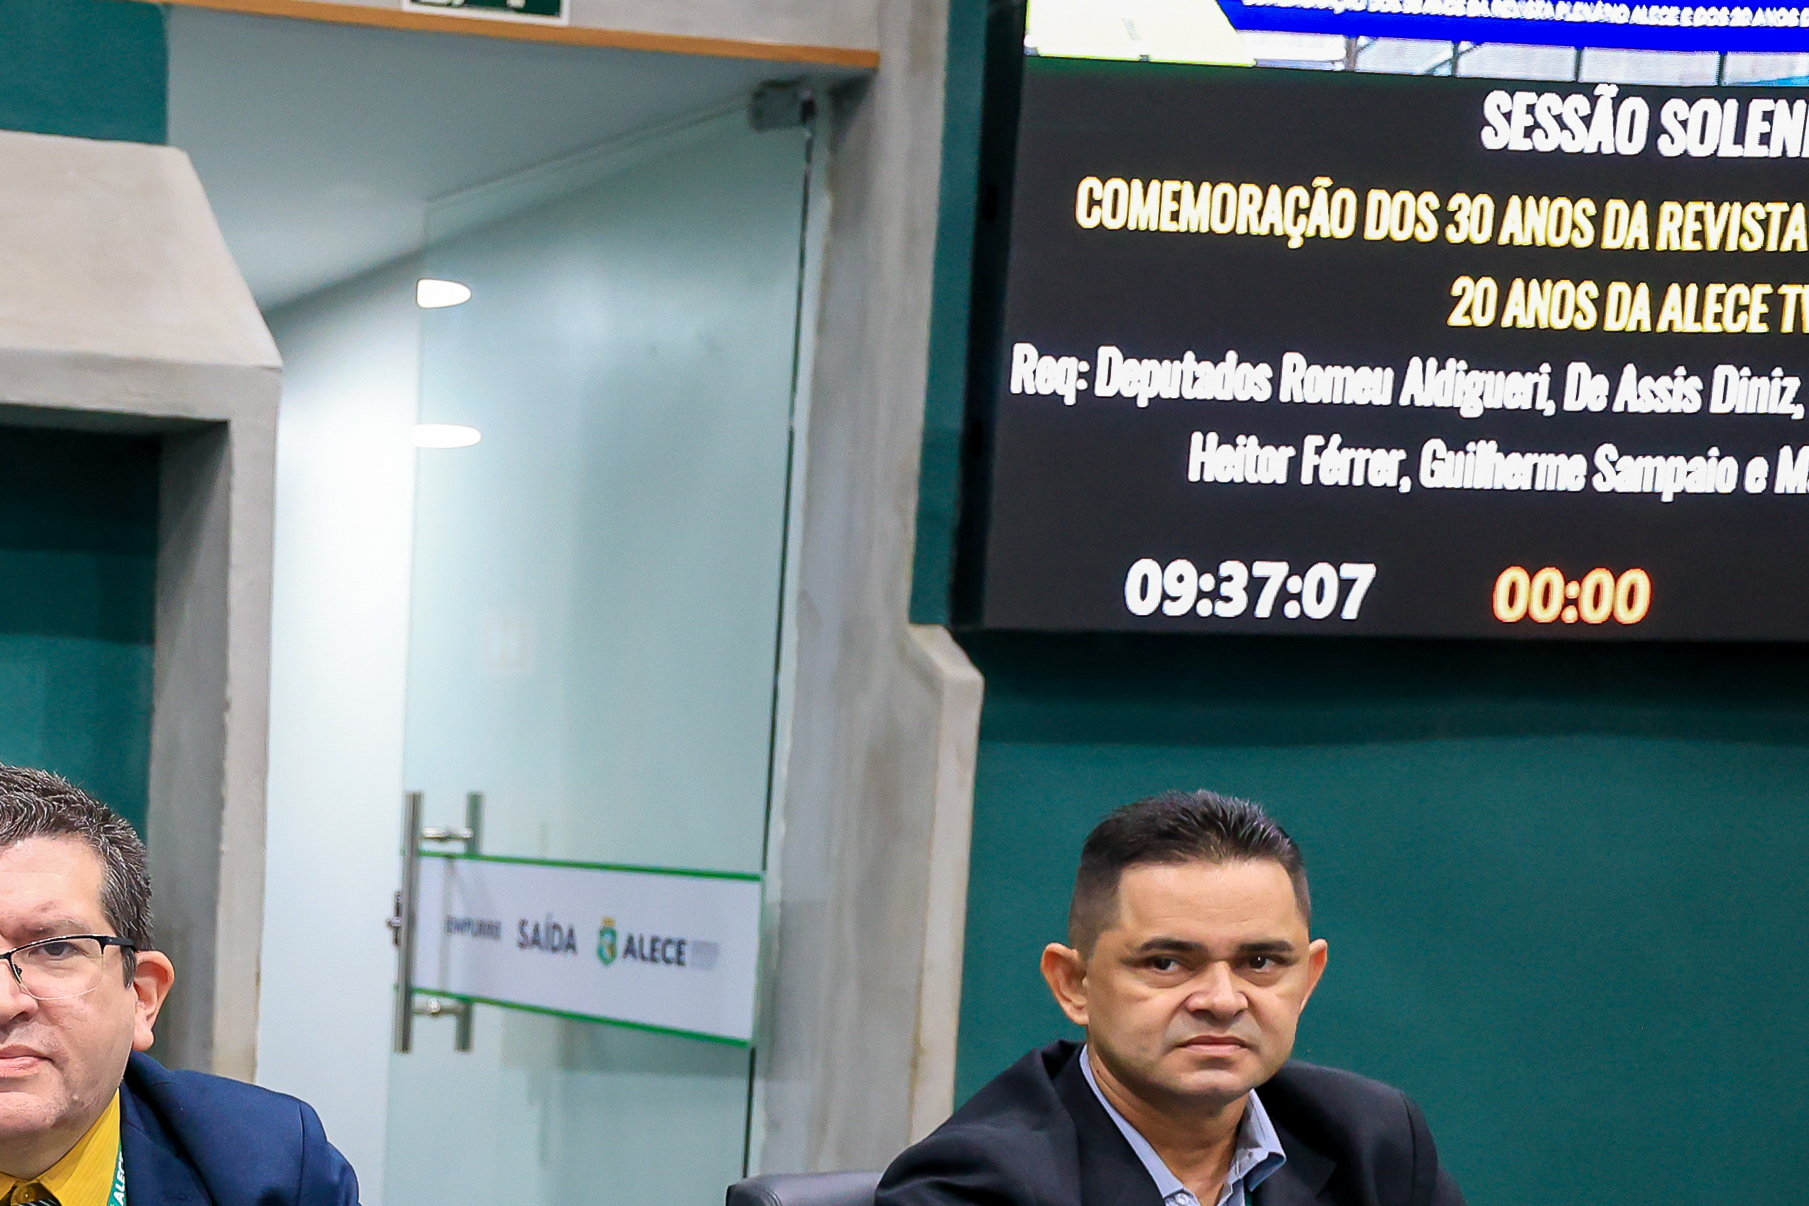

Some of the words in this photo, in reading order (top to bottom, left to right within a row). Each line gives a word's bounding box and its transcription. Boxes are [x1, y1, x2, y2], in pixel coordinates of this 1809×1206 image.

[1479, 83, 1650, 156] SESSÃO
[1075, 176, 1357, 248] COMEMORAÇÃO
[1363, 187, 1440, 243] DOS
[1445, 192, 1495, 245] 30
[1497, 195, 1596, 249] ANOS
[1601, 199, 1650, 251] DA
[1655, 201, 1809, 253] REVISTA
[1446, 275, 1498, 328] 20
[1500, 277, 1600, 331] ANOS
[1603, 281, 1652, 333] DA
[1656, 282, 1773, 334] ALECE
[1009, 342, 1090, 406] Req:
[1094, 345, 1273, 408] Deputados
[1279, 352, 1394, 406] Romeu
[1399, 356, 1556, 418] Aldigueri,
[1563, 361, 1610, 412] De
[1612, 363, 1703, 413] Assis
[1709, 364, 1805, 420] Diniz,
[1187, 431, 1296, 484] Heitor
[1300, 433, 1412, 493] Férrer,
[1419, 438, 1588, 492] Guilherme
[1591, 443, 1739, 503] Sampaio
[1744, 456, 1769, 494] e
[1774, 445, 1809, 494] M
[1124, 558, 1377, 620] 09:37:07
[1492, 565, 1652, 625] 00:00
[517, 912, 578, 956] SAÍDA
[621, 931, 688, 967] ALECE
